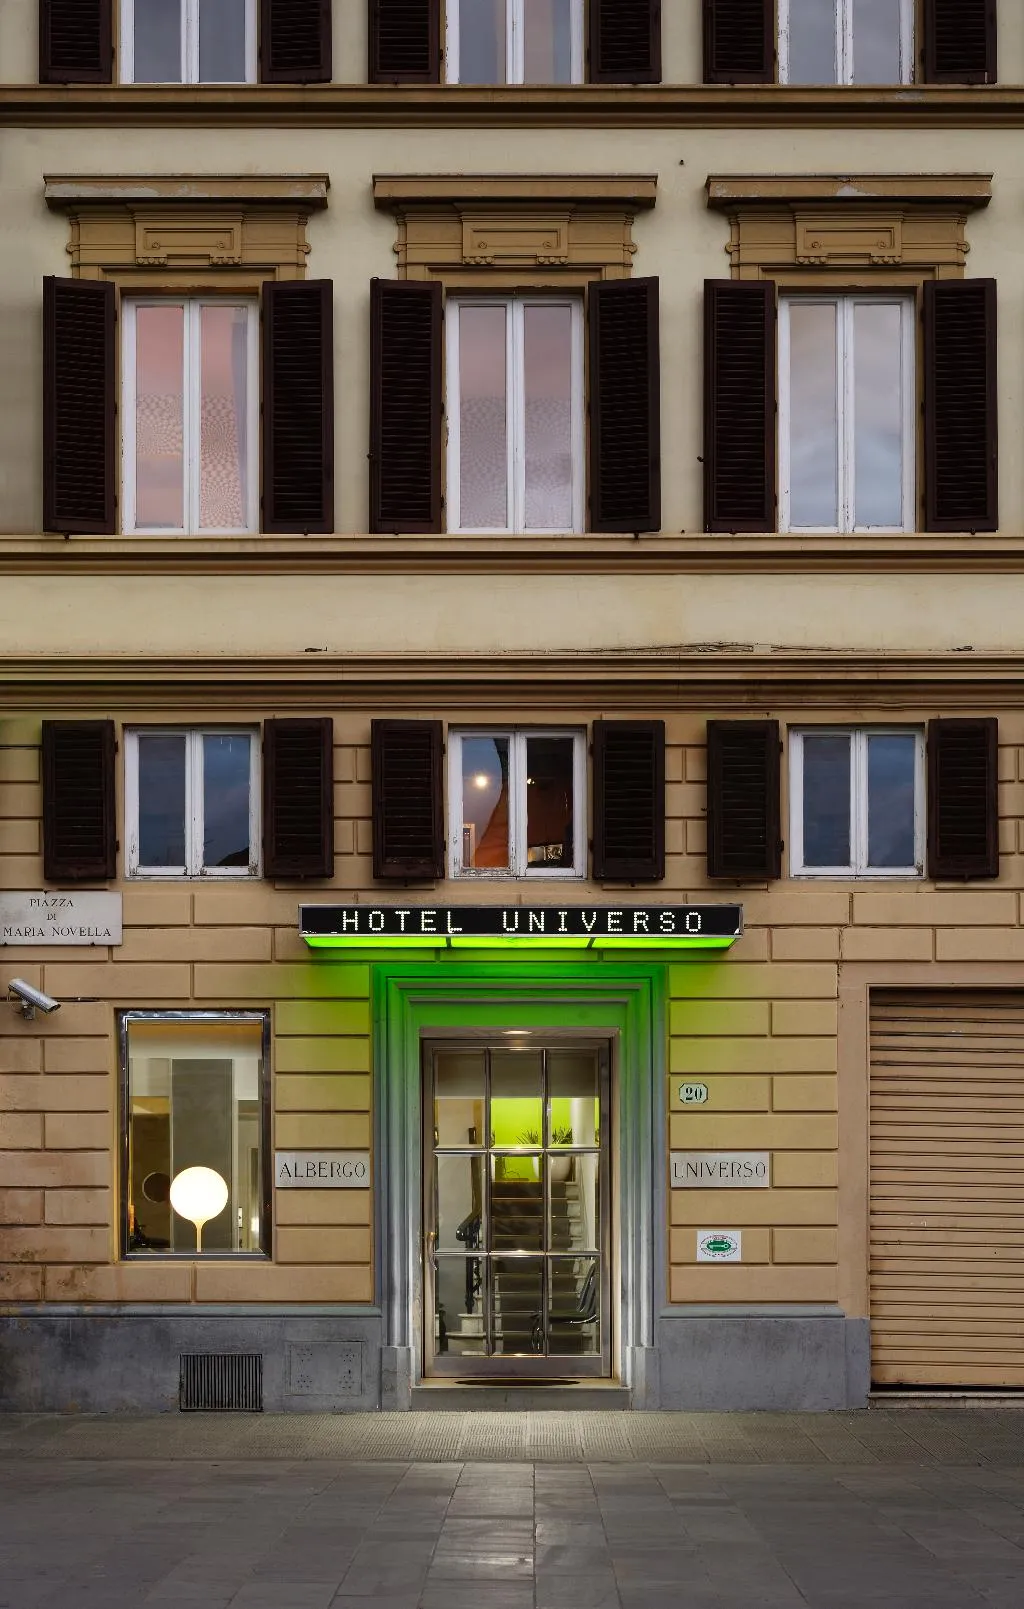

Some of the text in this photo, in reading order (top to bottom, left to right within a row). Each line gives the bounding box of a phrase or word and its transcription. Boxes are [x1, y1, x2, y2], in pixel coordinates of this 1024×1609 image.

[30, 898, 74, 907] PIAZZA
[46, 913, 57, 921] DI
[342, 910, 702, 932] HOTEL UNIVERSO
[3, 926, 112, 937] MARIA NOVELLA
[685, 1087, 703, 1101] 20
[279, 1161, 366, 1178] ALBERGO
[673, 1161, 766, 1178] UNIVERSO
